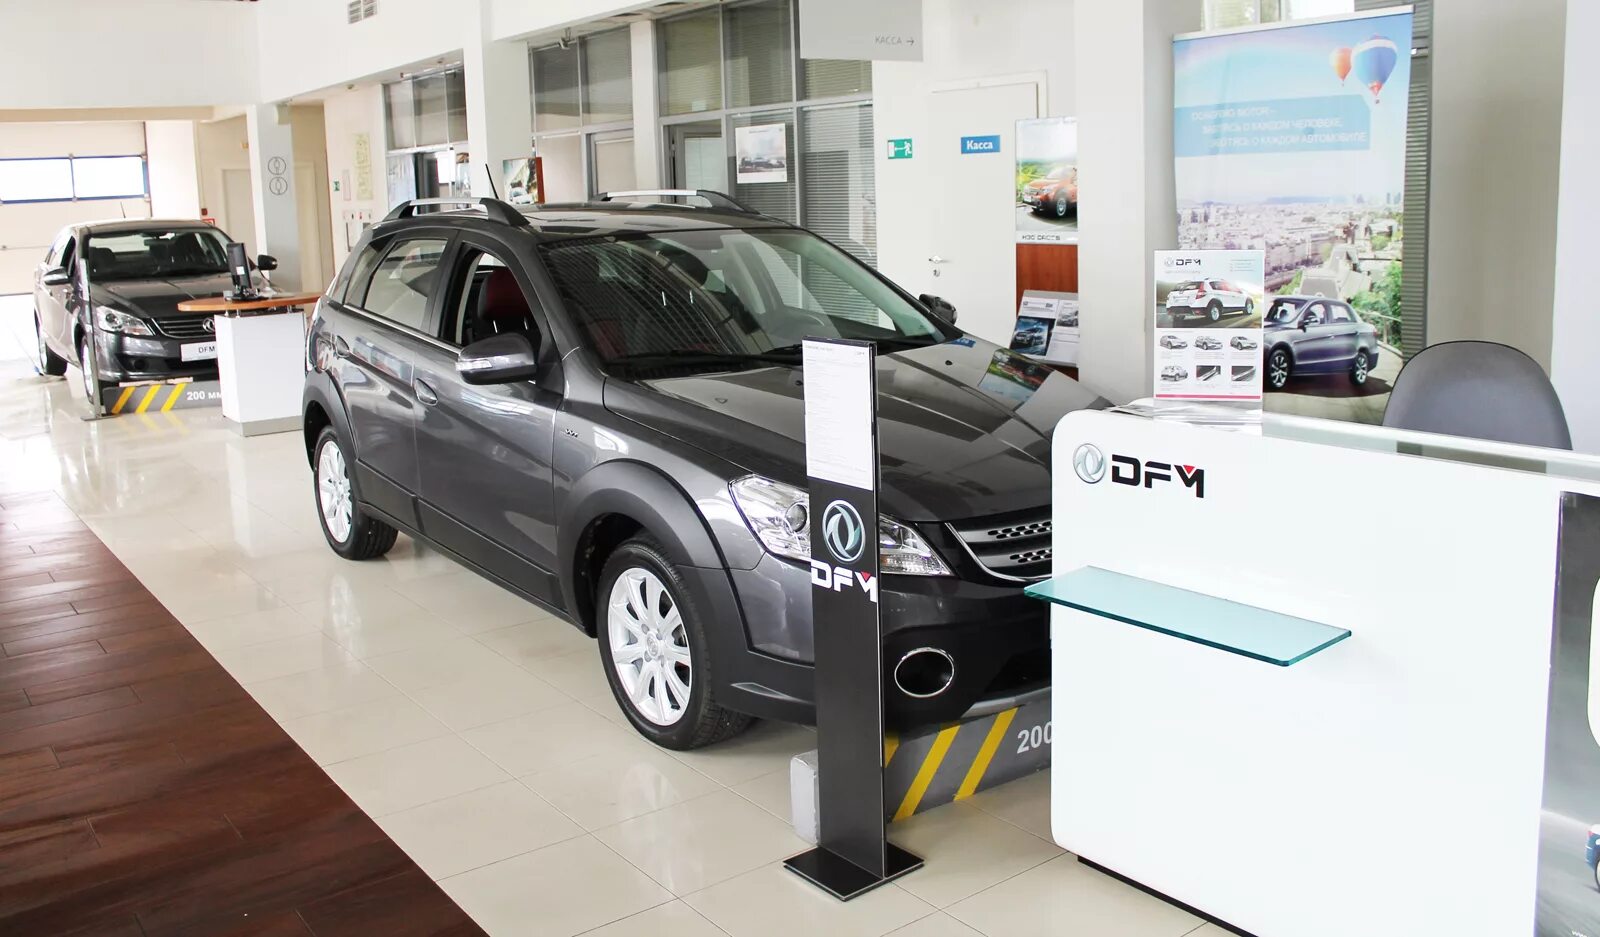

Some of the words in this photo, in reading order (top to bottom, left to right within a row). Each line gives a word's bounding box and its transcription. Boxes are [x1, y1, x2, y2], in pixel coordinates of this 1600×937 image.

[875, 36, 902, 45] КАССА
[966, 140, 993, 150] Касса
[198, 345, 215, 354] DFM
[187, 390, 205, 400] 200
[1111, 453, 1205, 499] DFM
[810, 559, 878, 603] DFM
[1017, 721, 1052, 754] 200
